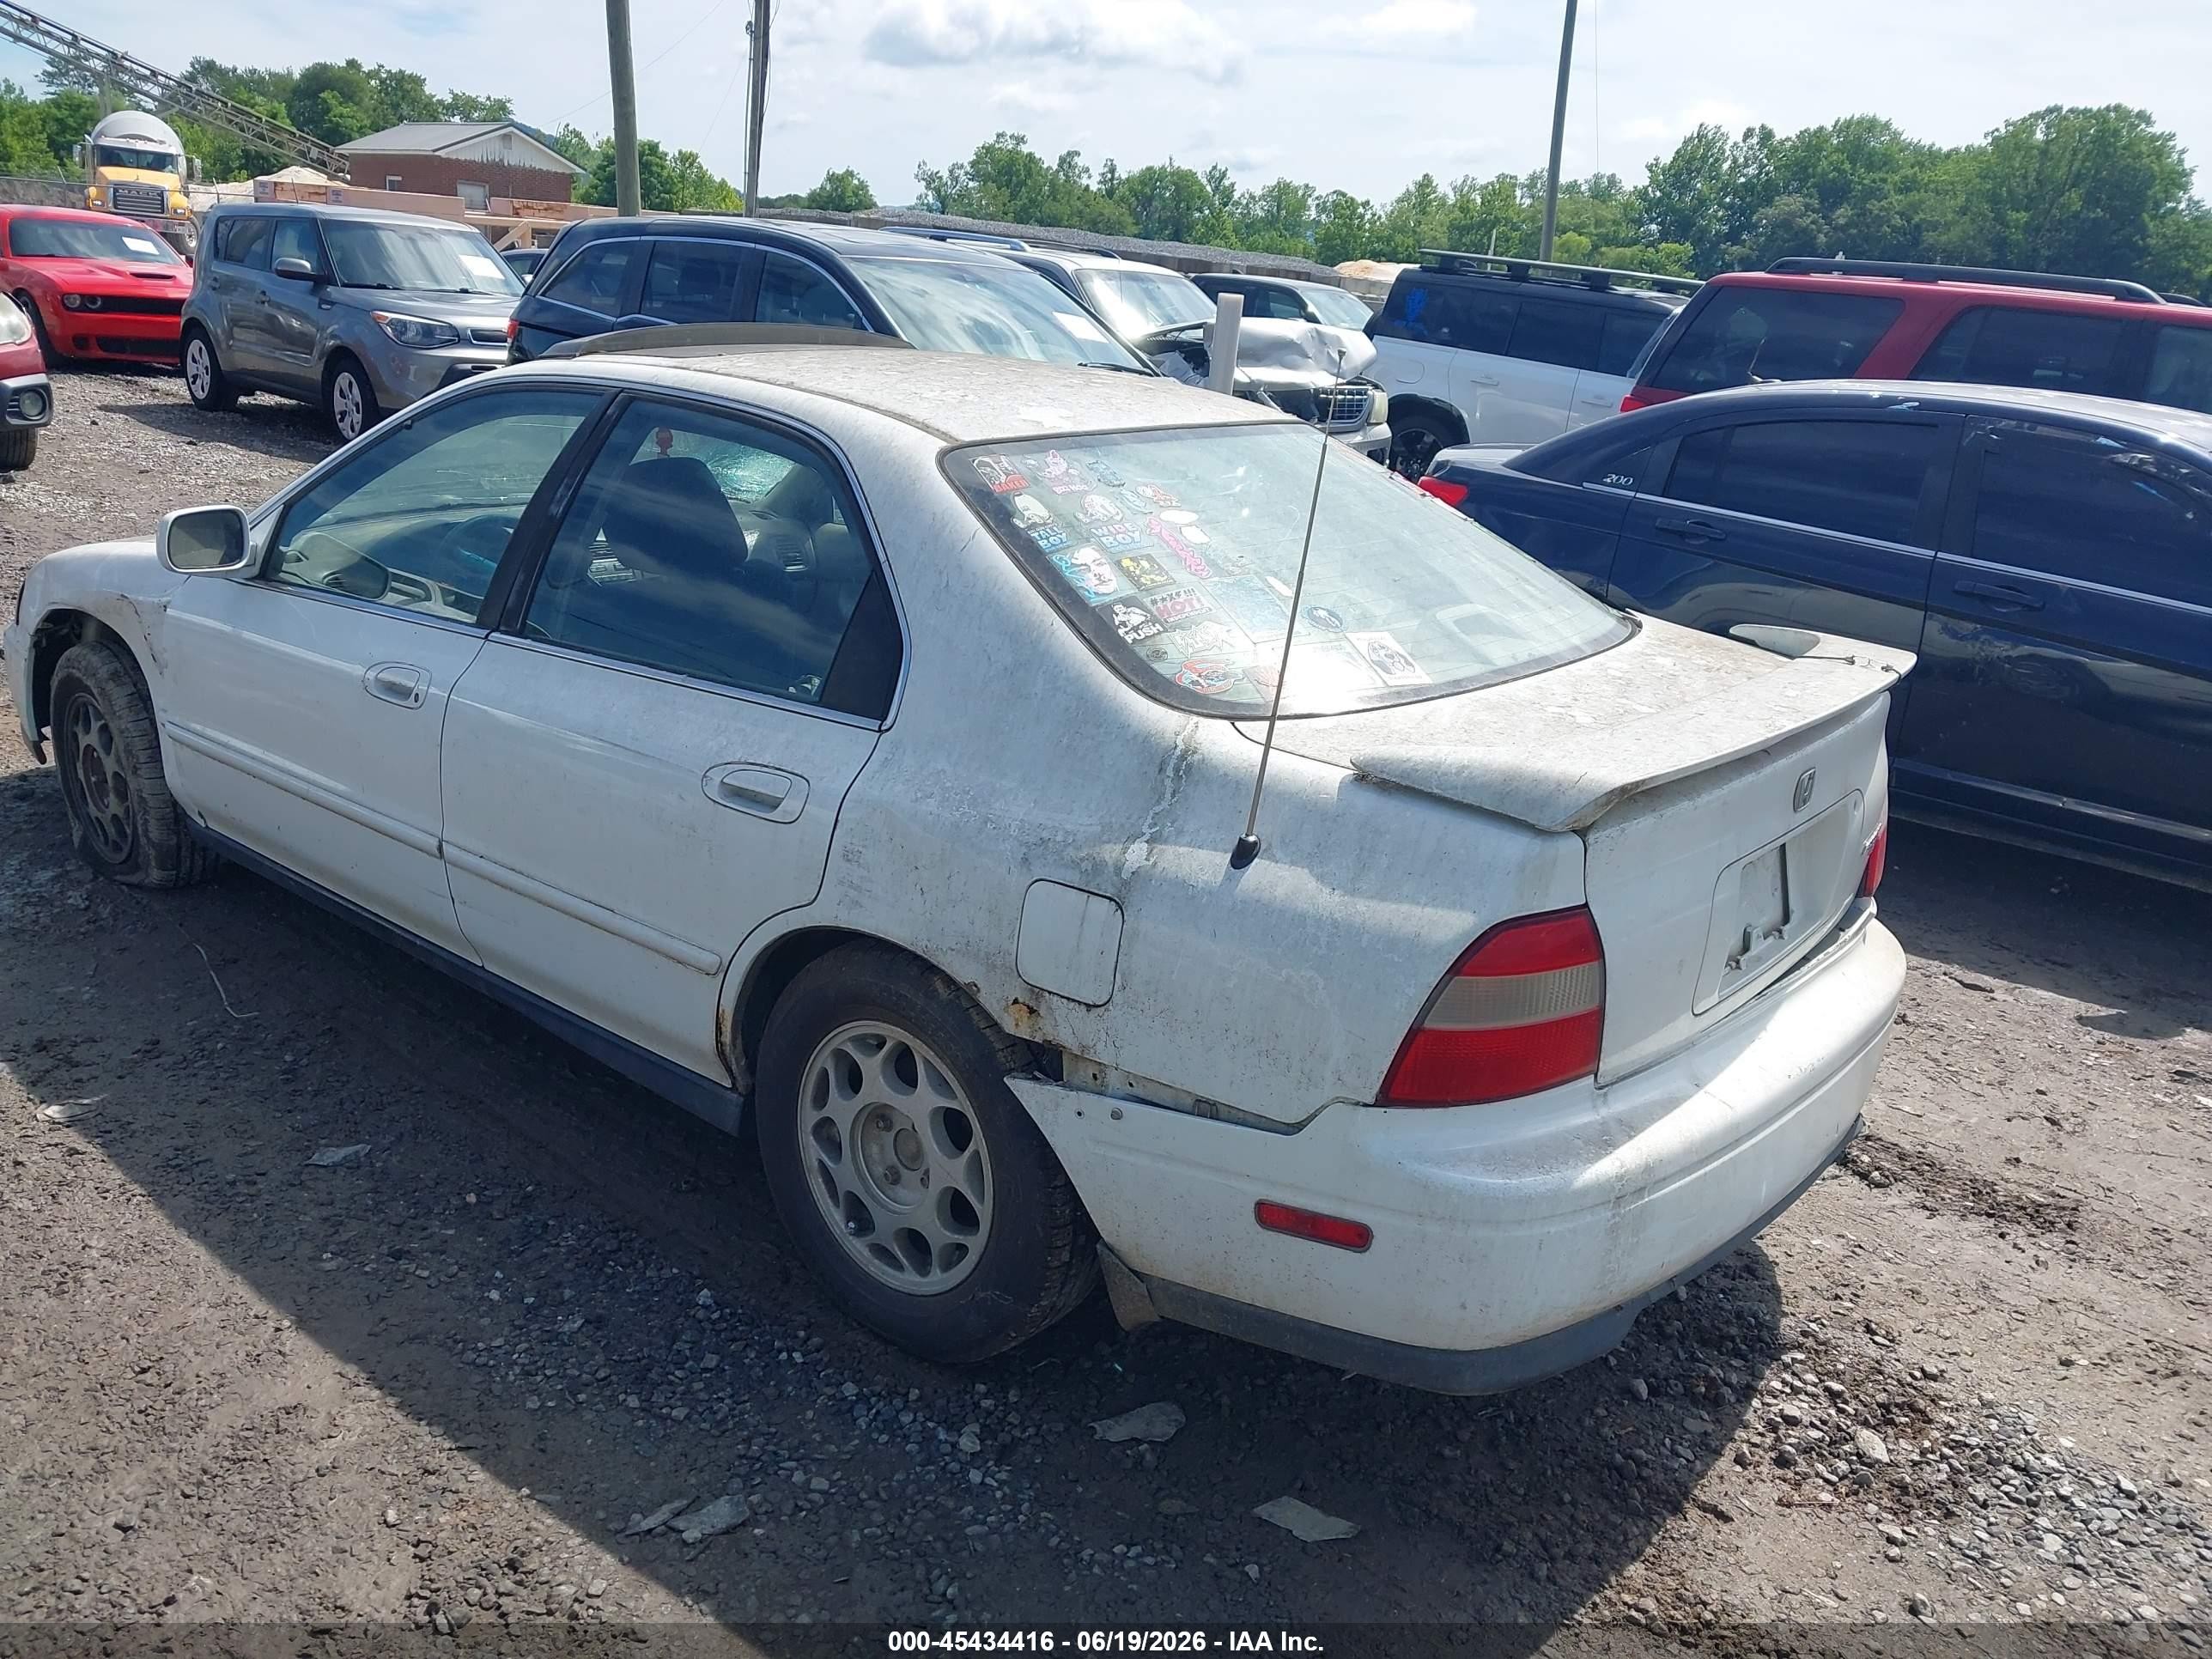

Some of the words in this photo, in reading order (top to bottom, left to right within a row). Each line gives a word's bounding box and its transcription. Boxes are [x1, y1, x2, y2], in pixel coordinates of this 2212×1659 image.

[1602, 473, 1634, 486] 200
[1030, 526, 1063, 540] TALL
[1091, 522, 1138, 537] WIDE
[1038, 532, 1067, 550] BOY
[1100, 531, 1142, 548] BOY
[1124, 623, 1164, 644] PUSH
